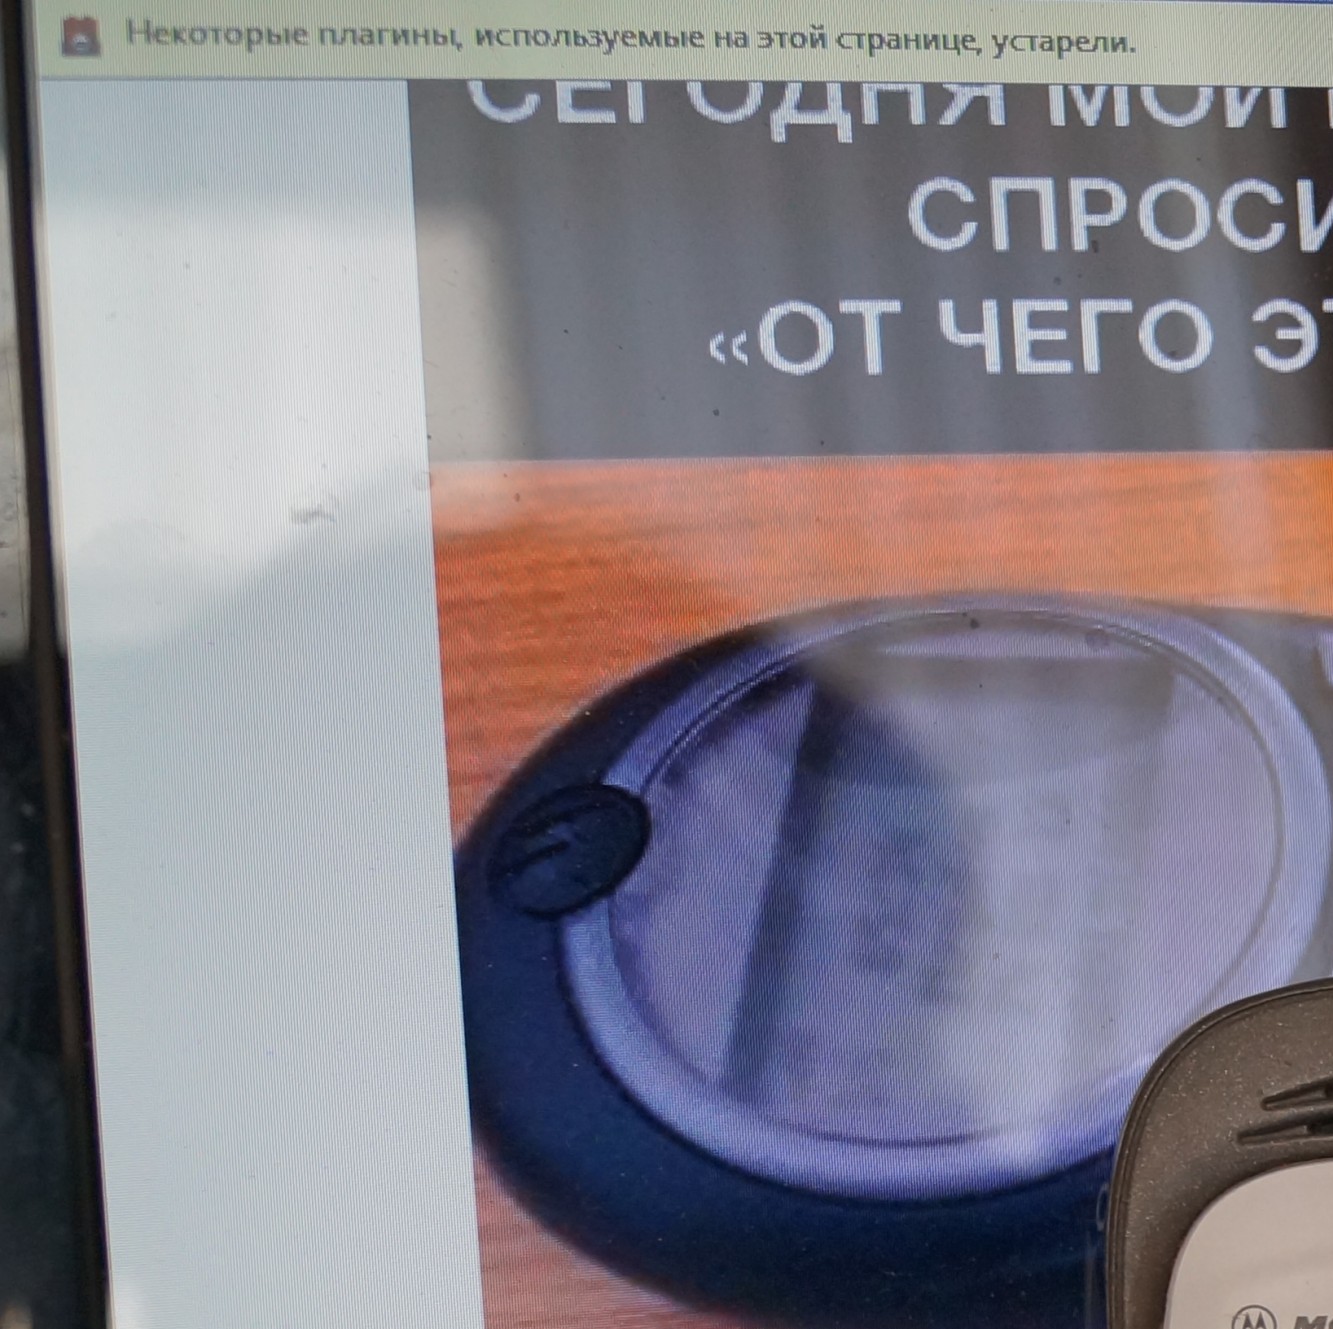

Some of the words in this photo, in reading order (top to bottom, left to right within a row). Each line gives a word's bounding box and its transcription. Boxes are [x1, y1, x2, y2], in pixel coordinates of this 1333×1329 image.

[126, 17, 310, 52] Некоторые
[320, 24, 463, 52] плагины,
[476, 26, 705, 57] используемые
[714, 31, 750, 50] на
[757, 25, 828, 51] этой
[836, 31, 984, 59] странице,
[993, 33, 1137, 59] устарели.
[707, 299, 903, 376] «ОТ
[939, 299, 1214, 376] ЧЕГО
